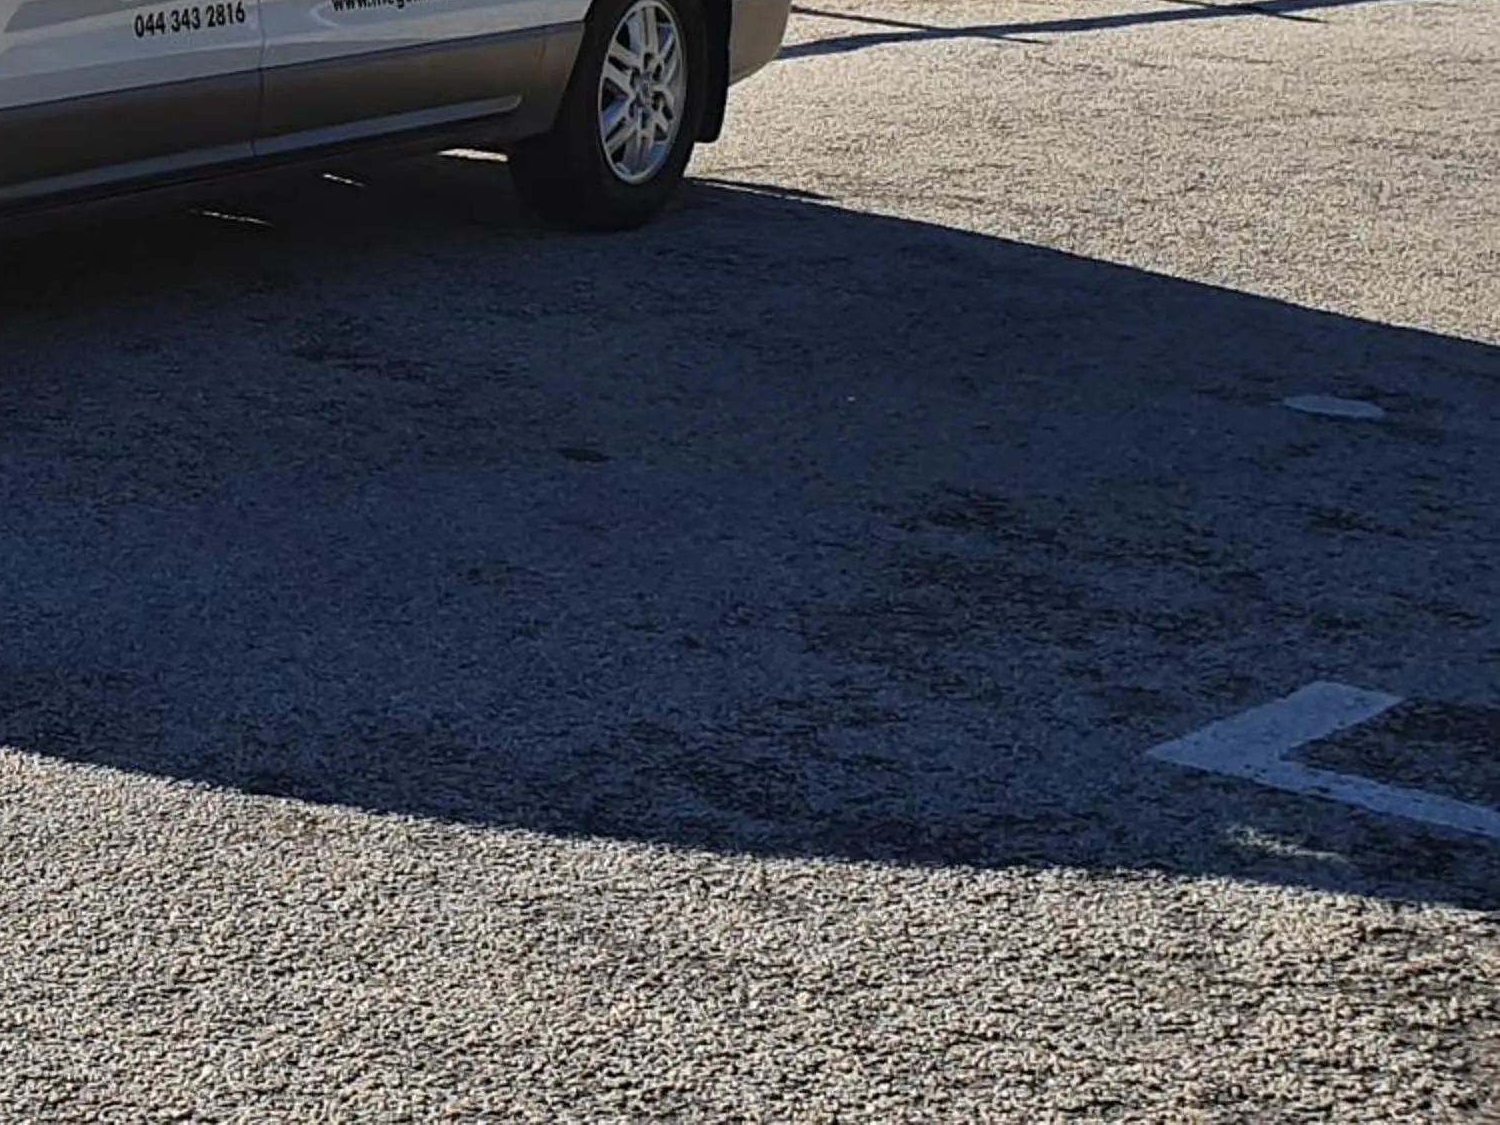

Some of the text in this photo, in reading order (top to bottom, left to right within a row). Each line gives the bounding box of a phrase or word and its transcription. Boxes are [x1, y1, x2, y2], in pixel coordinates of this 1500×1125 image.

[135, 0, 246, 38] 044 343 2816
